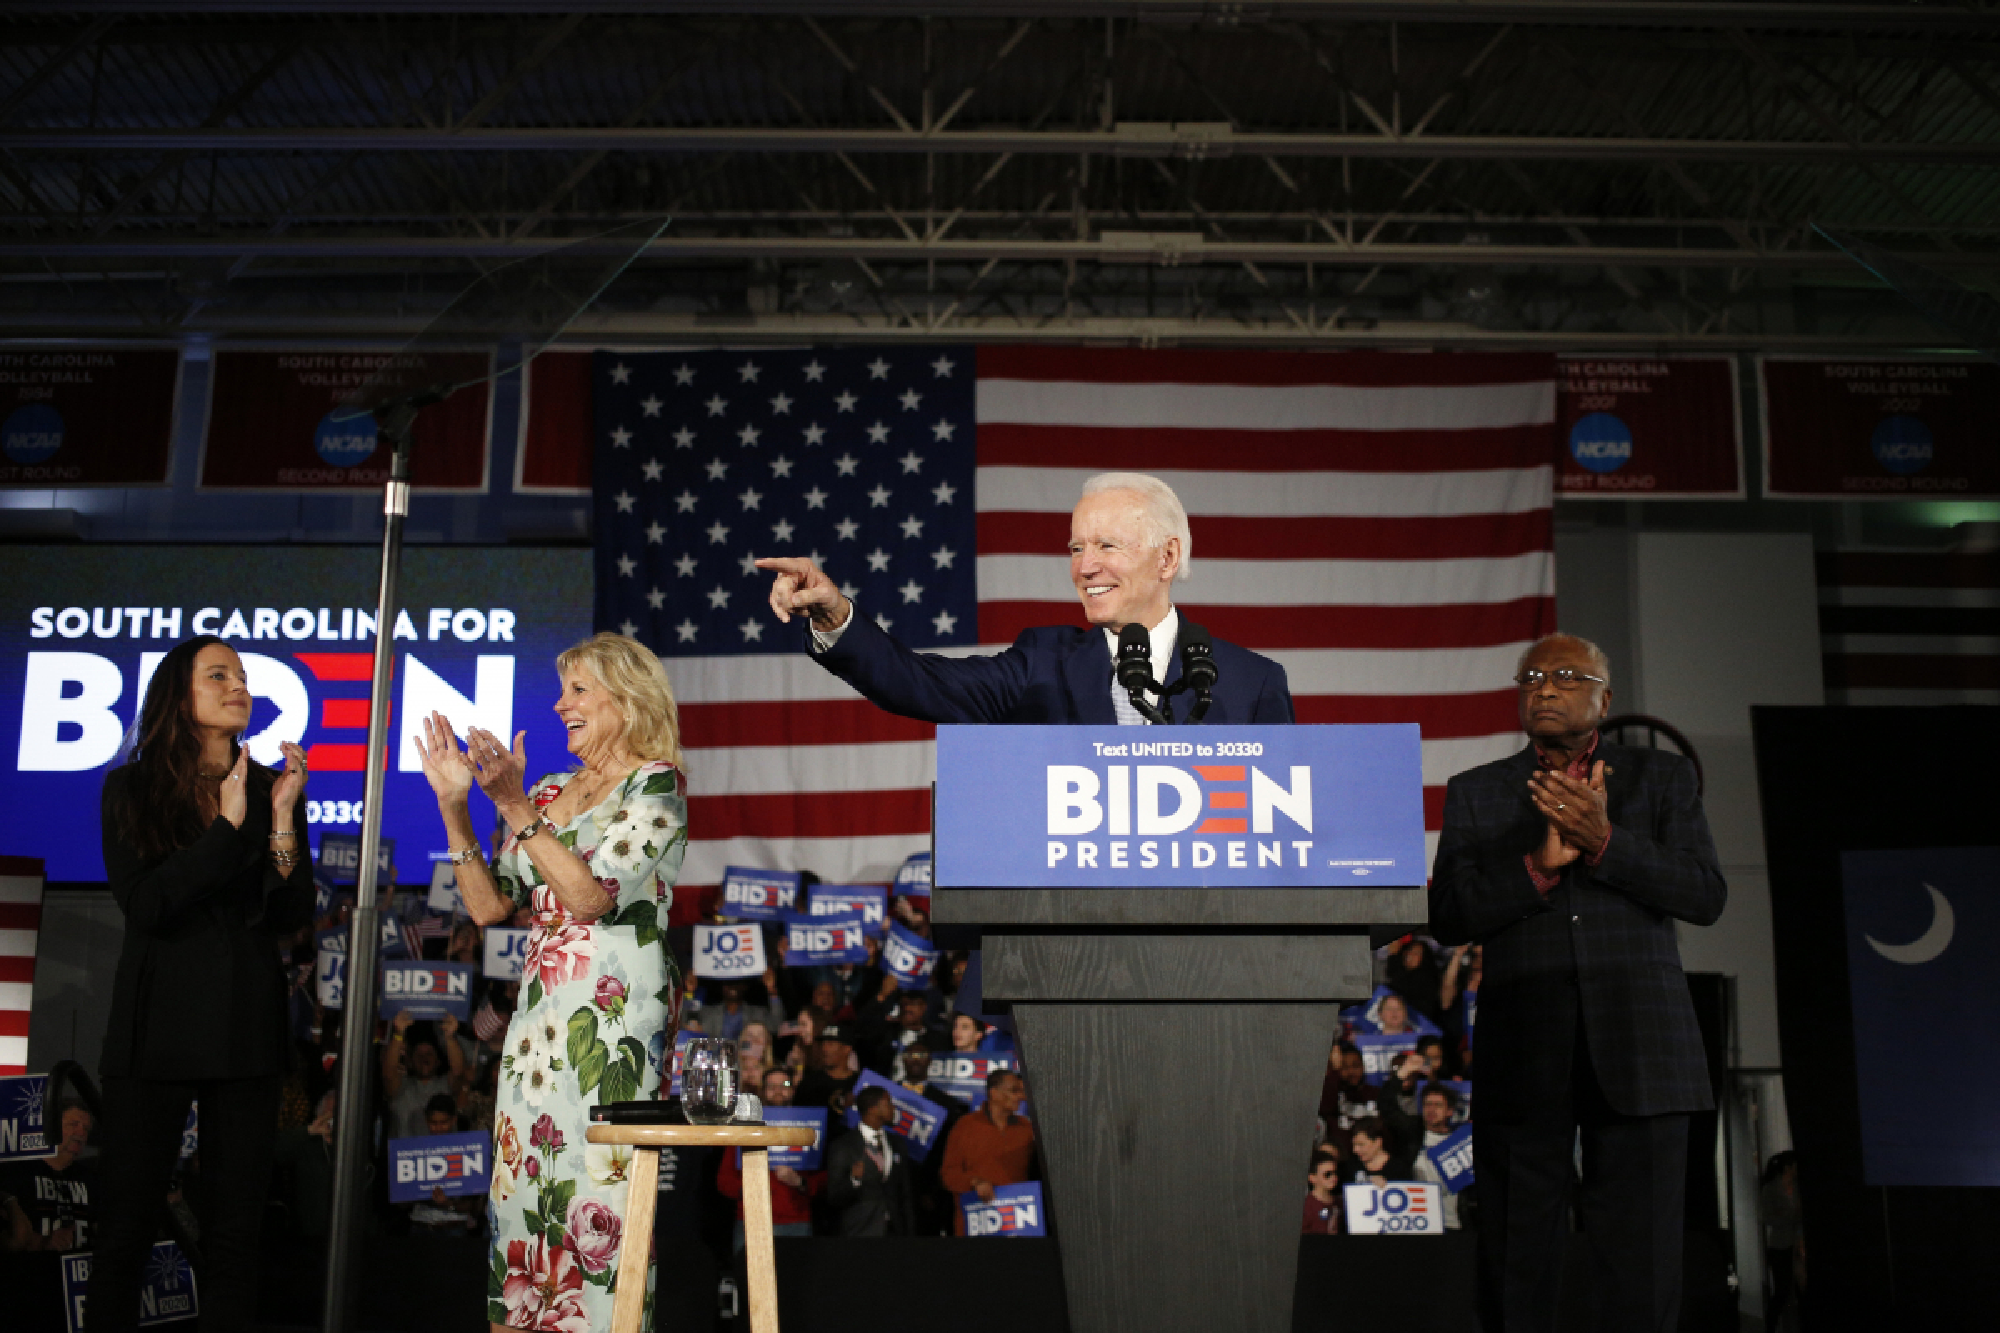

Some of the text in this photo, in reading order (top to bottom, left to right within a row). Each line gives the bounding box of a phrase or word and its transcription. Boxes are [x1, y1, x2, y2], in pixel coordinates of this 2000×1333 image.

[29, 354, 116, 367] CAROLINA
[277, 356, 336, 369] SOUTH
[1583, 362, 1670, 376] CAROLINA
[1824, 365, 1968, 378] SOUTH CAROLINA
[1847, 381, 1953, 395] VOLLEYBALL
[7, 432, 63, 448] NCAA
[320, 435, 377, 452] NCAA
[1575, 441, 1631, 458] NCAA
[1879, 443, 1933, 459] NCAA
[22, 466, 81, 479] ROUND
[277, 467, 390, 483] SECOND ROUN
[1597, 474, 1656, 488] ROUND
[1842, 476, 1968, 490] SECOND ROUND
[29, 606, 516, 642] SOUTH CAROLINA FOR
[1092, 742, 1263, 756] Text UNITED to 30330
[1046, 765, 1313, 835] BIDEN
[1047, 840, 1313, 868] PRESIDENT
[726, 882, 796, 908] BIDEN
[702, 928, 753, 954] JOE
[790, 926, 863, 951] BIDEN
[712, 955, 754, 970] 2020
[384, 969, 468, 994] BIDEN
[396, 1152, 484, 1183] BIDEN
[1362, 1187, 1427, 1216] JOE
[967, 1204, 1038, 1236] BIDEN
[1377, 1215, 1428, 1234] 2020
